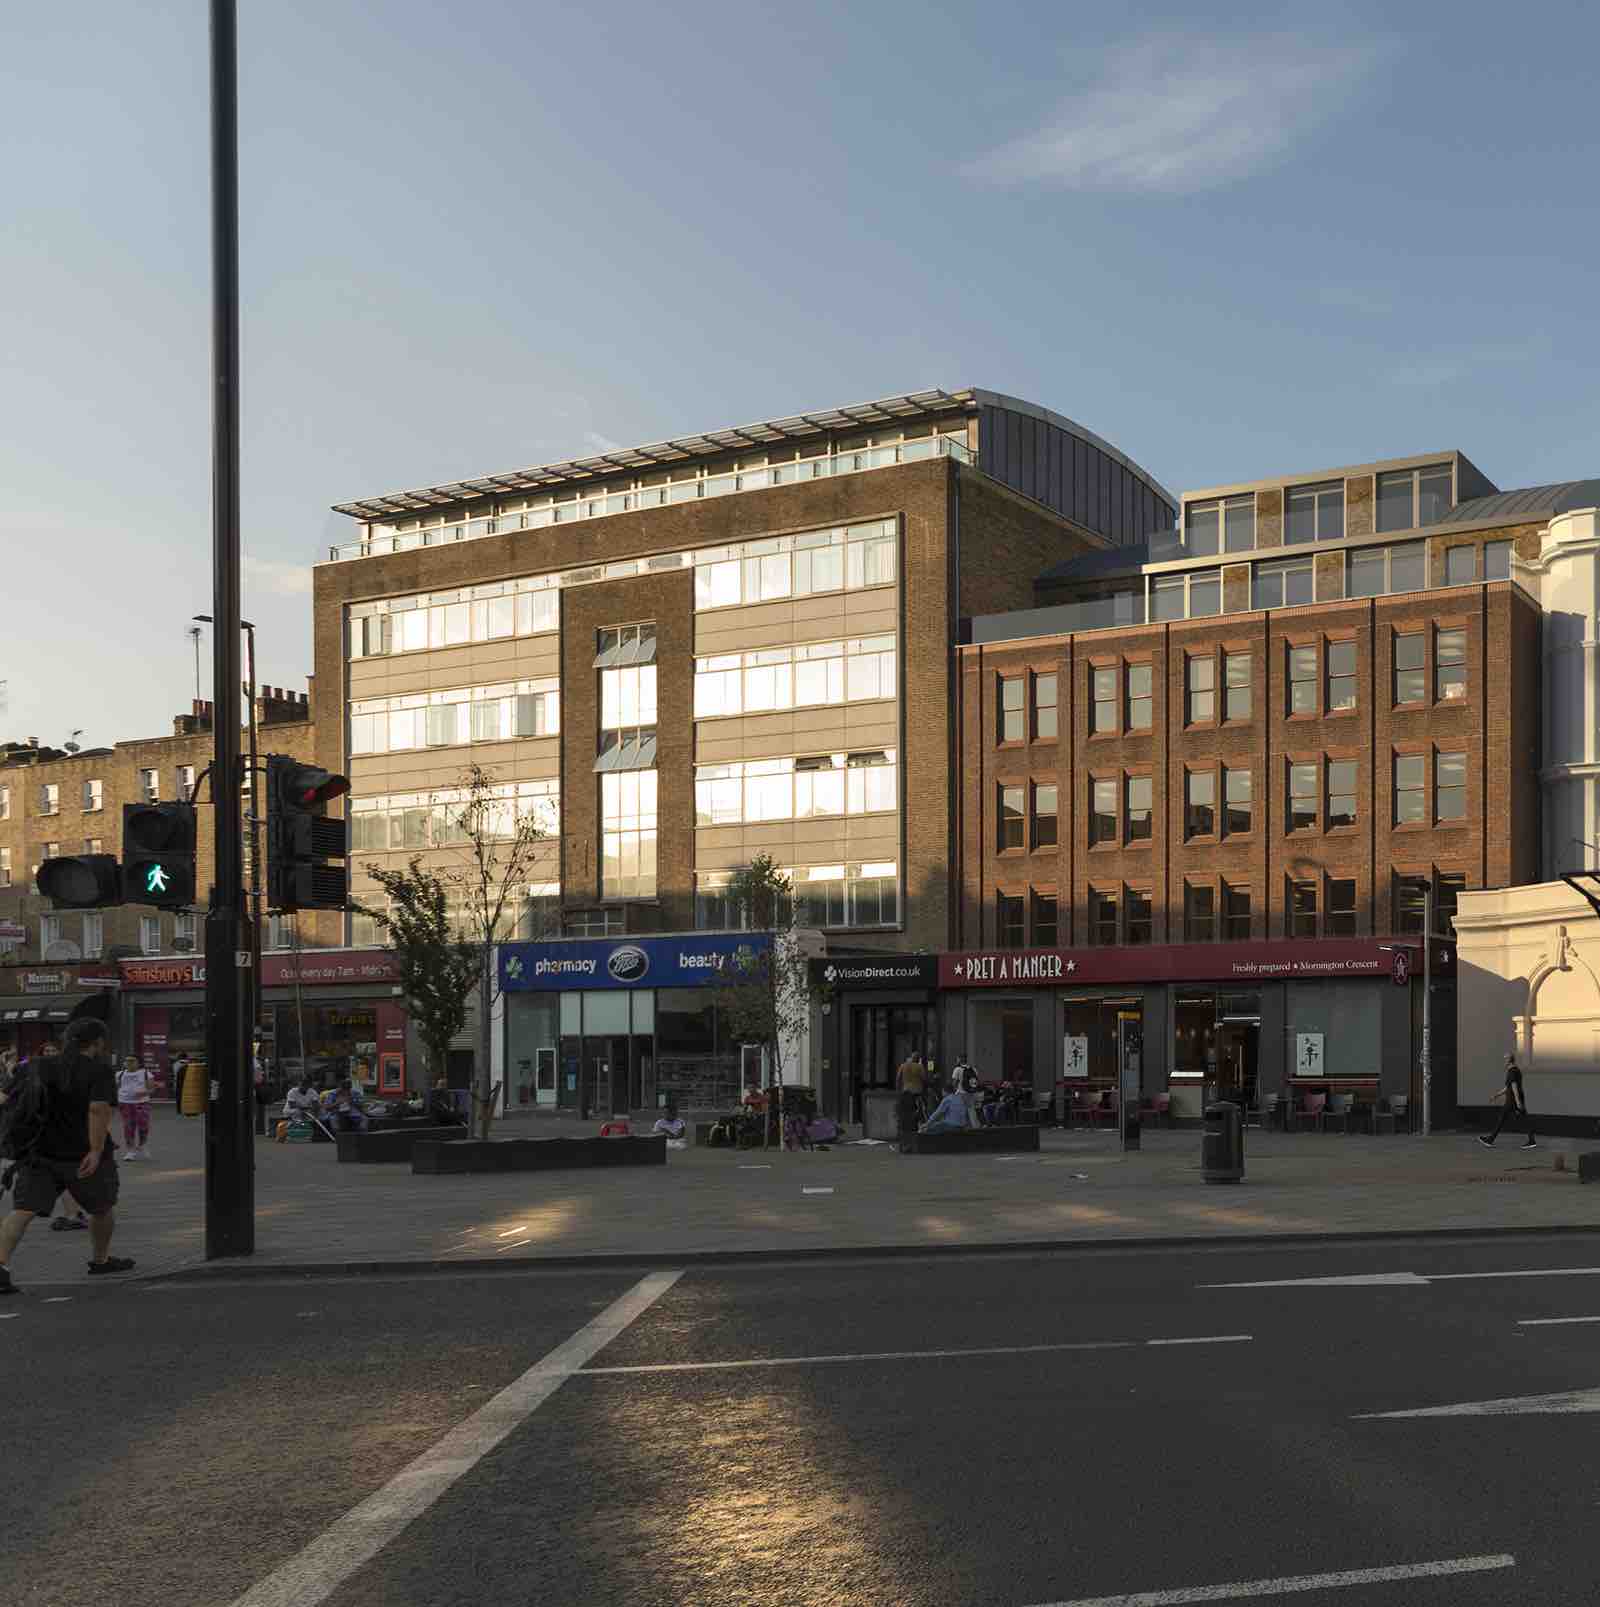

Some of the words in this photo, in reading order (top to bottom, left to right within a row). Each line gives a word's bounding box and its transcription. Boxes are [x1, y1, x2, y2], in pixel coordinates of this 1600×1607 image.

[240, 952, 249, 965] 7
[535, 957, 597, 975] pharmacy
[679, 951, 725, 969] beauty
[1232, 962, 1257, 974] Freshly
[1259, 960, 1291, 974] prepared
[1300, 960, 1345, 972] Mornington
[1346, 959, 1379, 969] Crescent
[838, 966, 921, 979] VisionDirect.co.uk
[966, 957, 996, 980] PRET
[1000, 957, 1008, 979] A
[1013, 955, 1063, 979] MANGER
